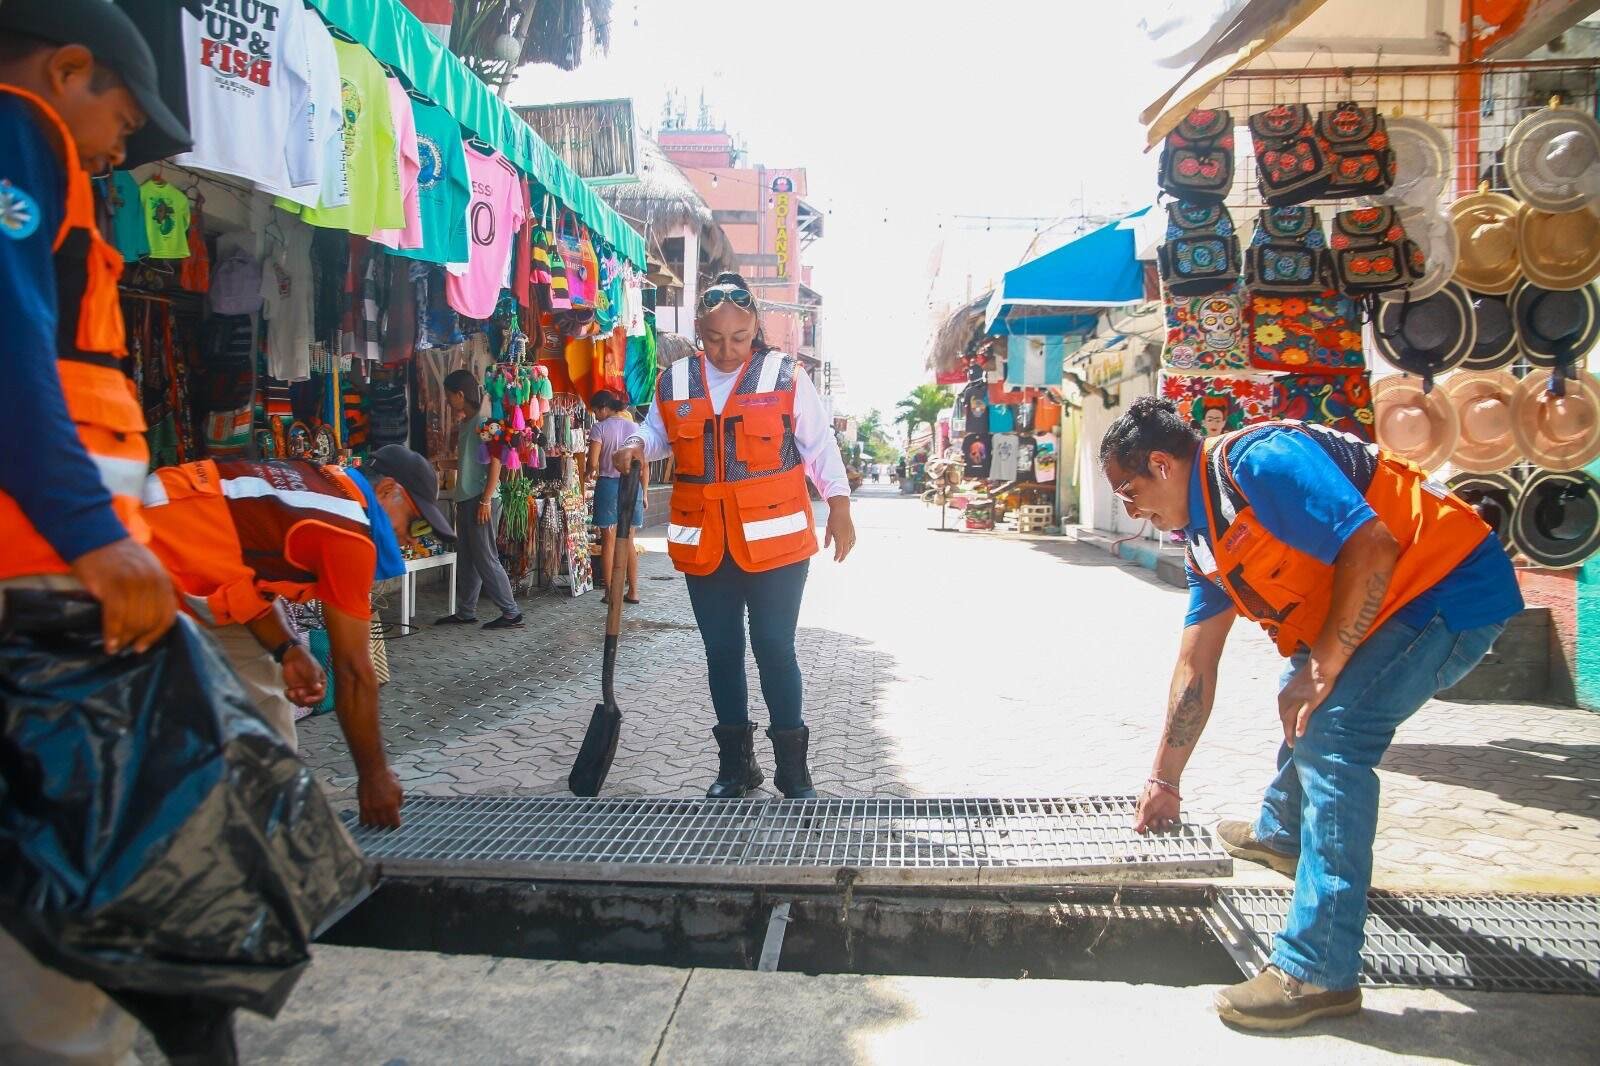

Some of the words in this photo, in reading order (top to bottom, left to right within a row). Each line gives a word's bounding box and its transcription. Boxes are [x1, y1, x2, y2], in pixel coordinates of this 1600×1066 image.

[203, 0, 279, 31] HUT
[200, 37, 272, 87] FISH
[776, 193, 789, 278] ROLANDI
